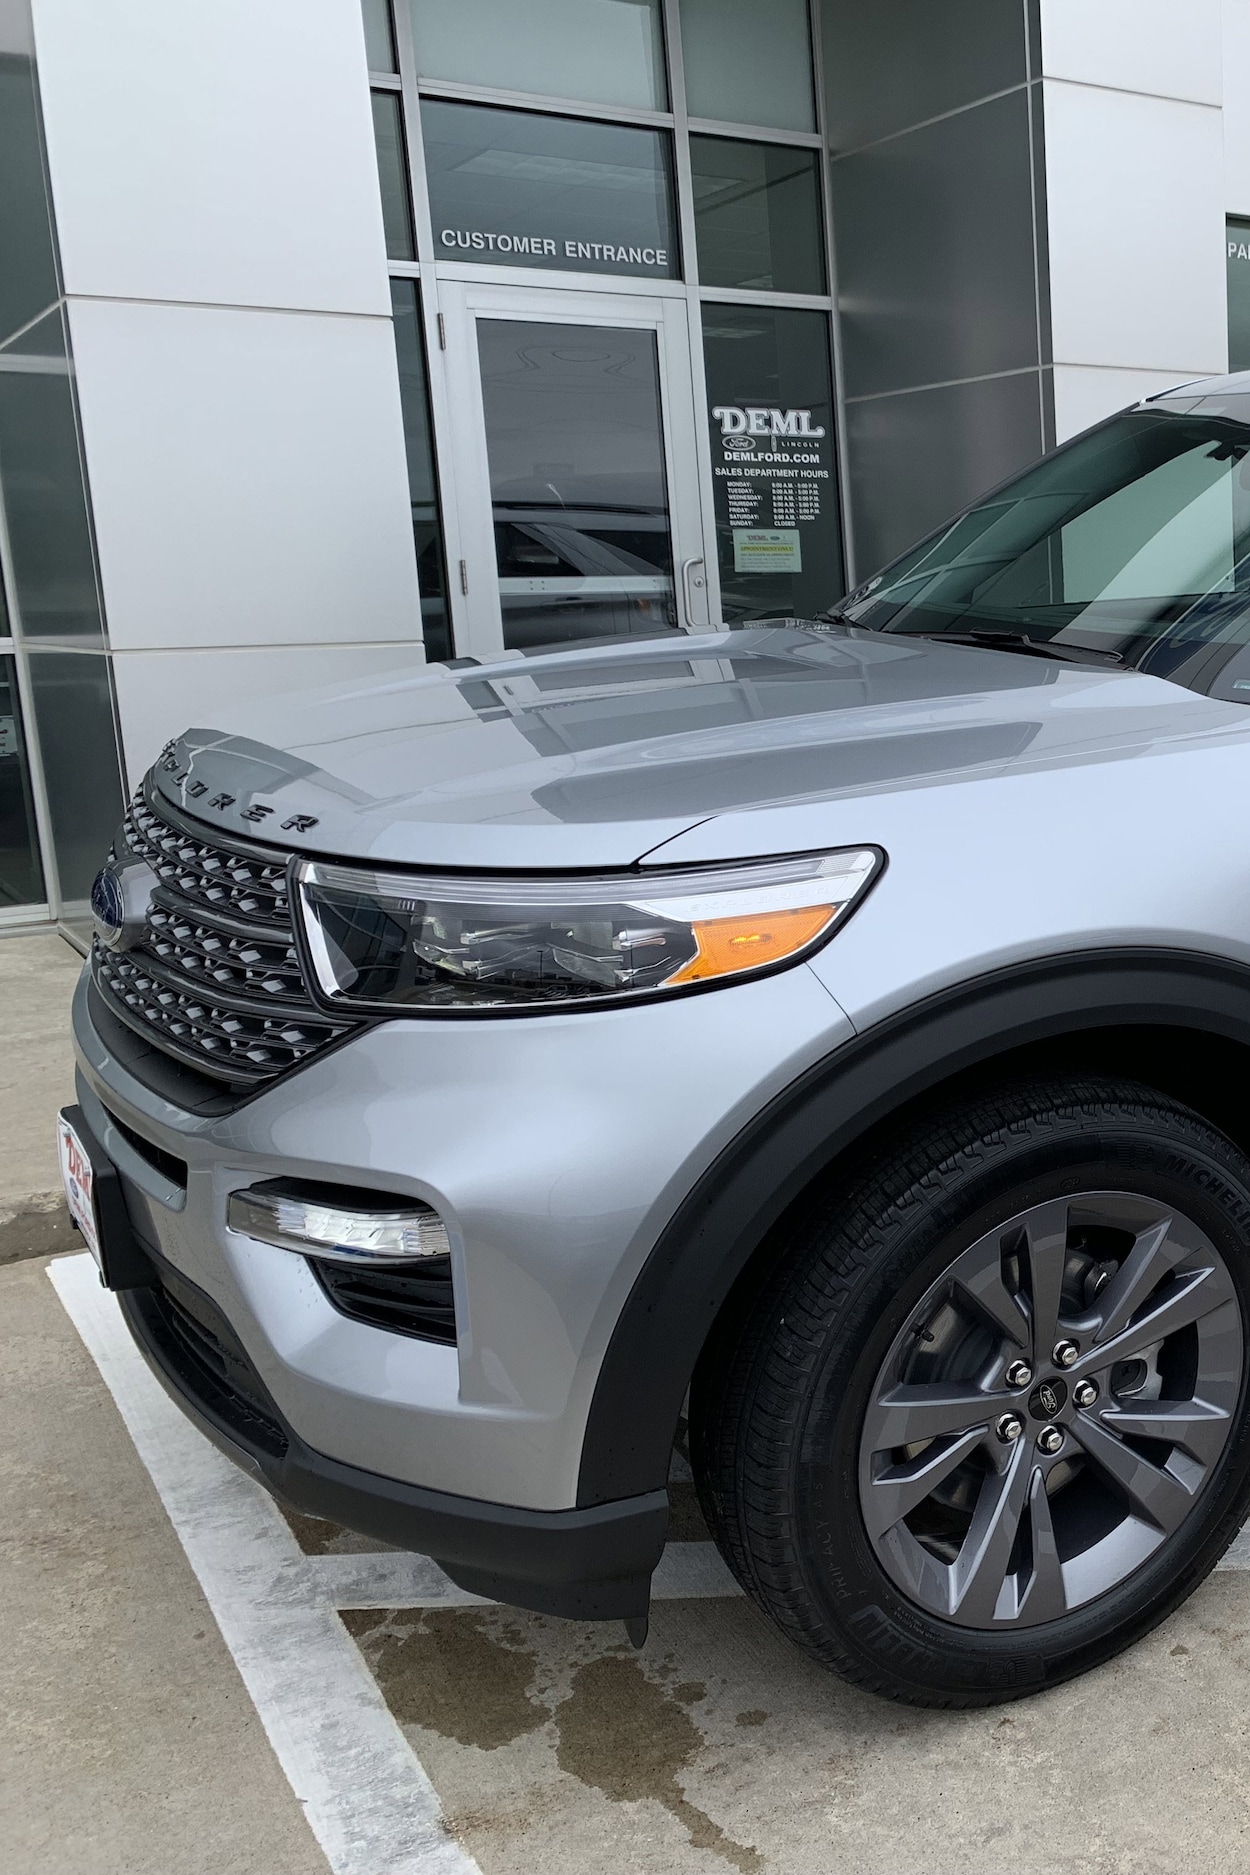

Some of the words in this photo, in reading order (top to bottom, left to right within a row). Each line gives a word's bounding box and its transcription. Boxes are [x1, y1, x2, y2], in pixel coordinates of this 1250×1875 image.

[441, 229, 556, 256] CUSTOMER
[565, 241, 668, 266] ENTRANCE
[712, 406, 825, 438] DEML
[715, 467, 742, 476] SALES
[744, 468, 799, 478] DEPARTMENT
[800, 469, 829, 478] HOURS
[724, 451, 820, 464] DEMLFORD.COM
[162, 738, 319, 833] PLORER
